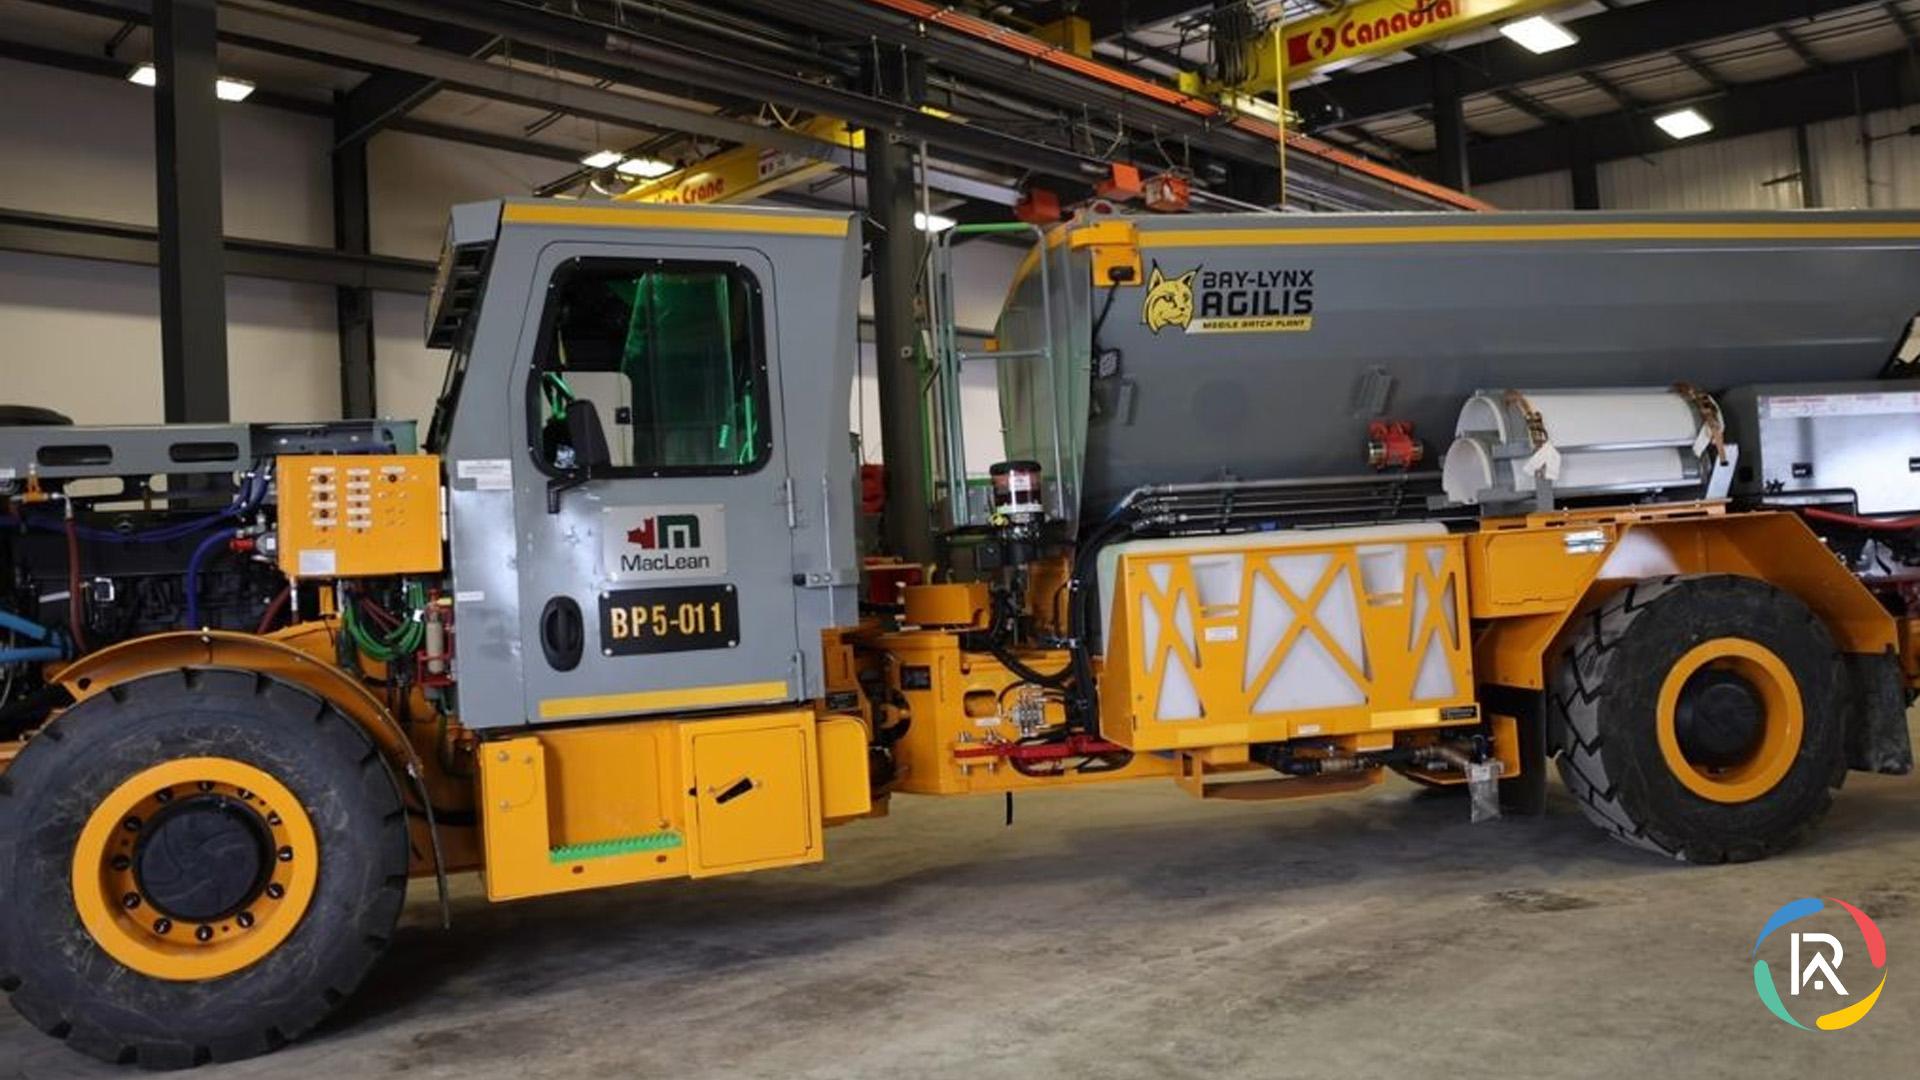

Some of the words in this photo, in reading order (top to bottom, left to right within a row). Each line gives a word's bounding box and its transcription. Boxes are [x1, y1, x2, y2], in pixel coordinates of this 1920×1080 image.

[1202, 270, 1314, 289] BAY-LYNX
[1201, 289, 1314, 317] AGILIS
[620, 554, 710, 572] MacLean
[610, 602, 722, 639] BP5-011
